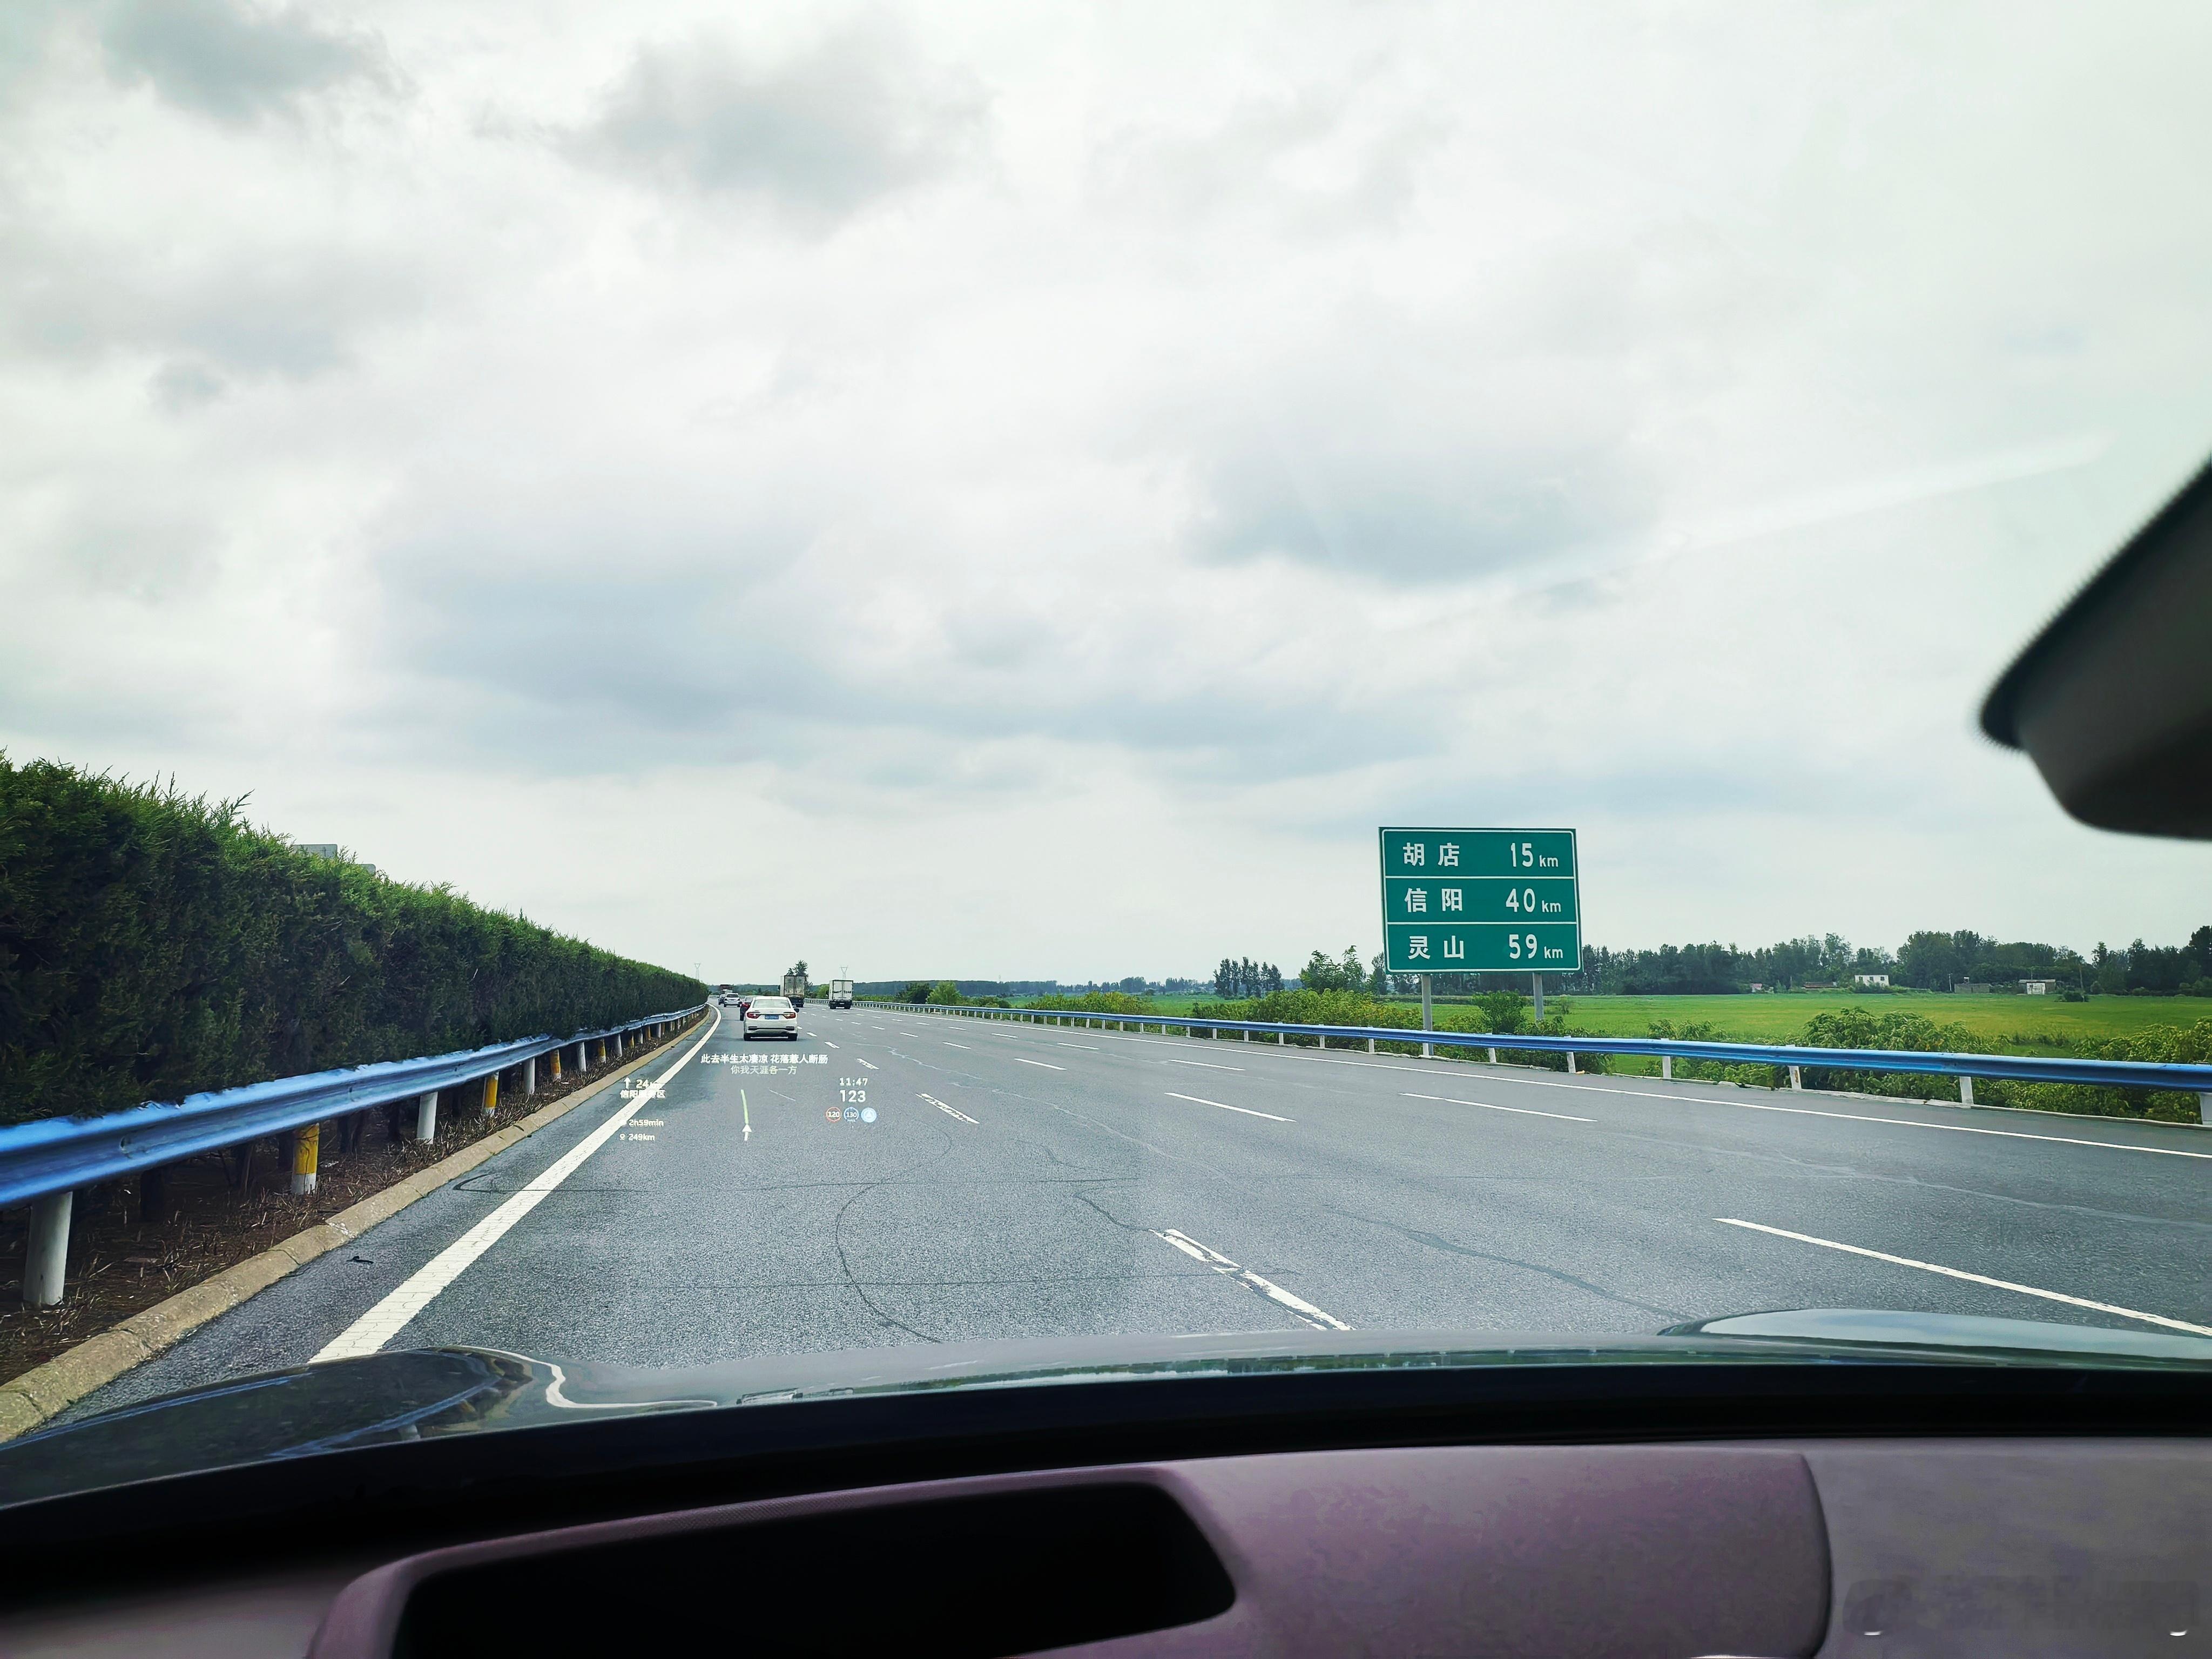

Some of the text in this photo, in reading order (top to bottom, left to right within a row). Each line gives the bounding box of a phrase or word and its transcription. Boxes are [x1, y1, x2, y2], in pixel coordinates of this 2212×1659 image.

[1403, 842, 1559, 867] 胡店 15 km
[1404, 888, 1561, 913] 信阳 40 km
[1408, 934, 1563, 959] 灵山 59 km
[730, 1065, 797, 1075] 你我天涯各一方
[839, 1077, 868, 1086] 11:47
[619, 1089, 666, 1099] 信阳区
[839, 1090, 866, 1102] 123
[628, 1133, 655, 1141] 249km
